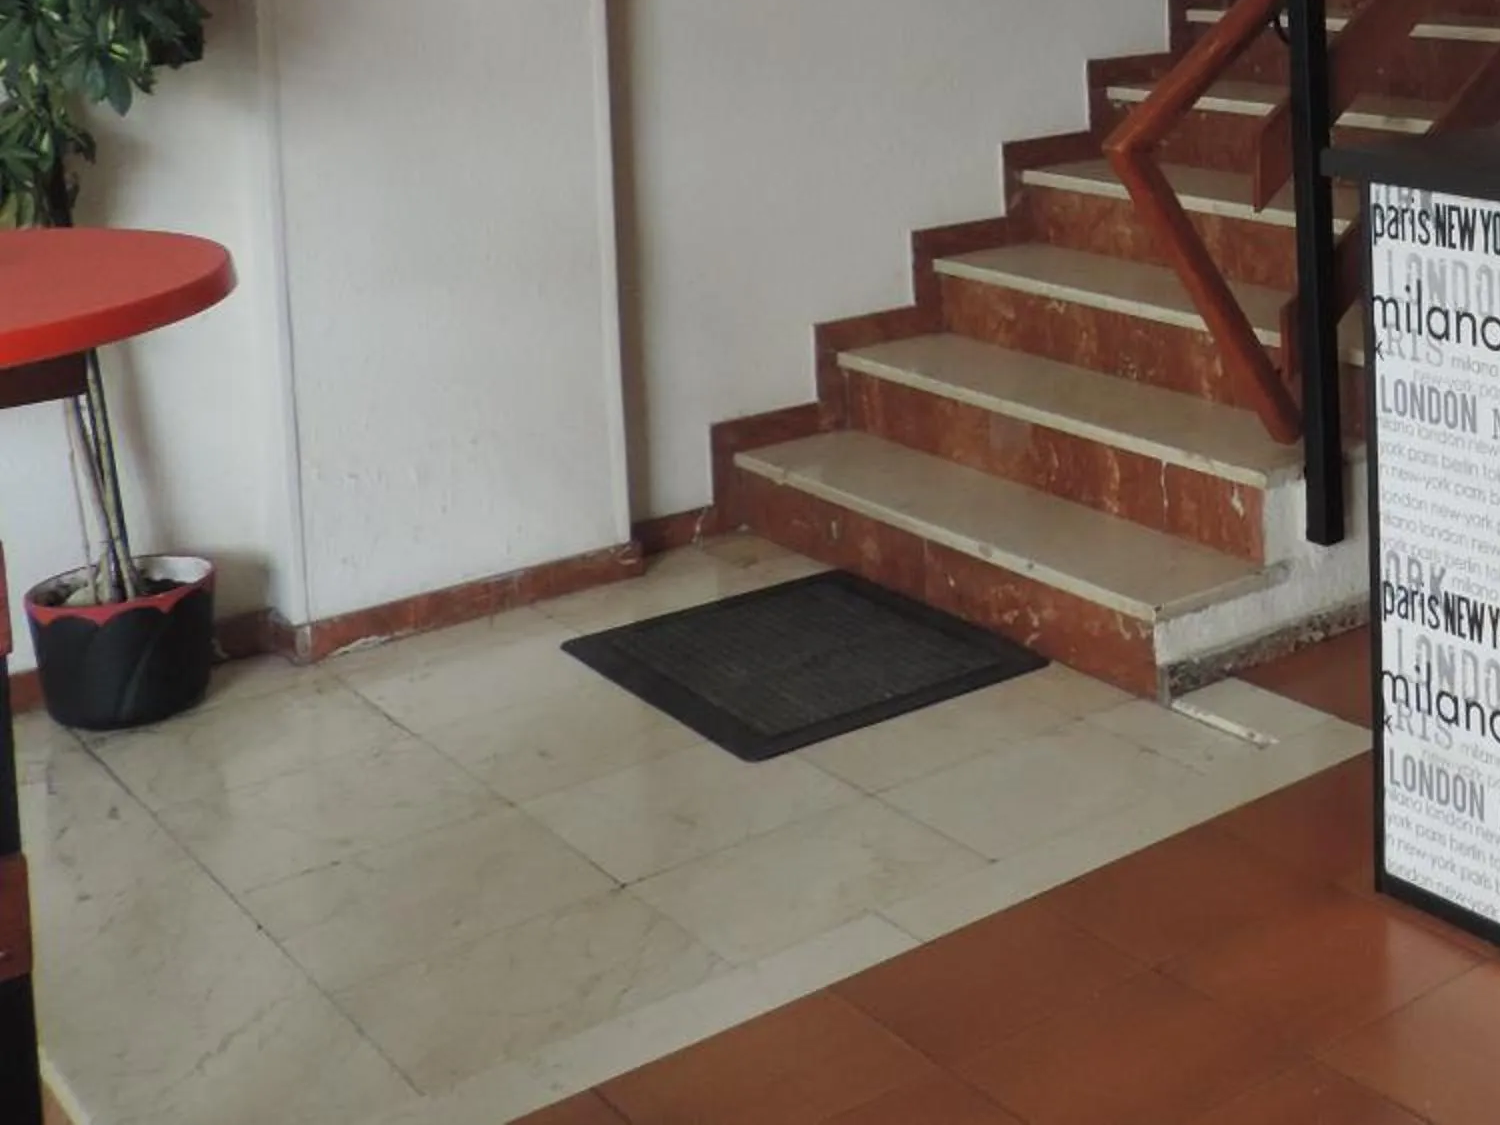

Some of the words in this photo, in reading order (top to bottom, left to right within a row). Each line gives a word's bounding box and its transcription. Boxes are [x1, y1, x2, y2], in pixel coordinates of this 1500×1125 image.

[1372, 197, 1430, 246] paris
[1434, 203, 1475, 252] NEW
[1385, 322, 1443, 367] RIS
[1379, 374, 1476, 434] LONDON
[1382, 578, 1439, 630] paris
[1444, 591, 1484, 645] NEW
[1395, 697, 1453, 750] RIS
[1388, 747, 1484, 822] LONDON
